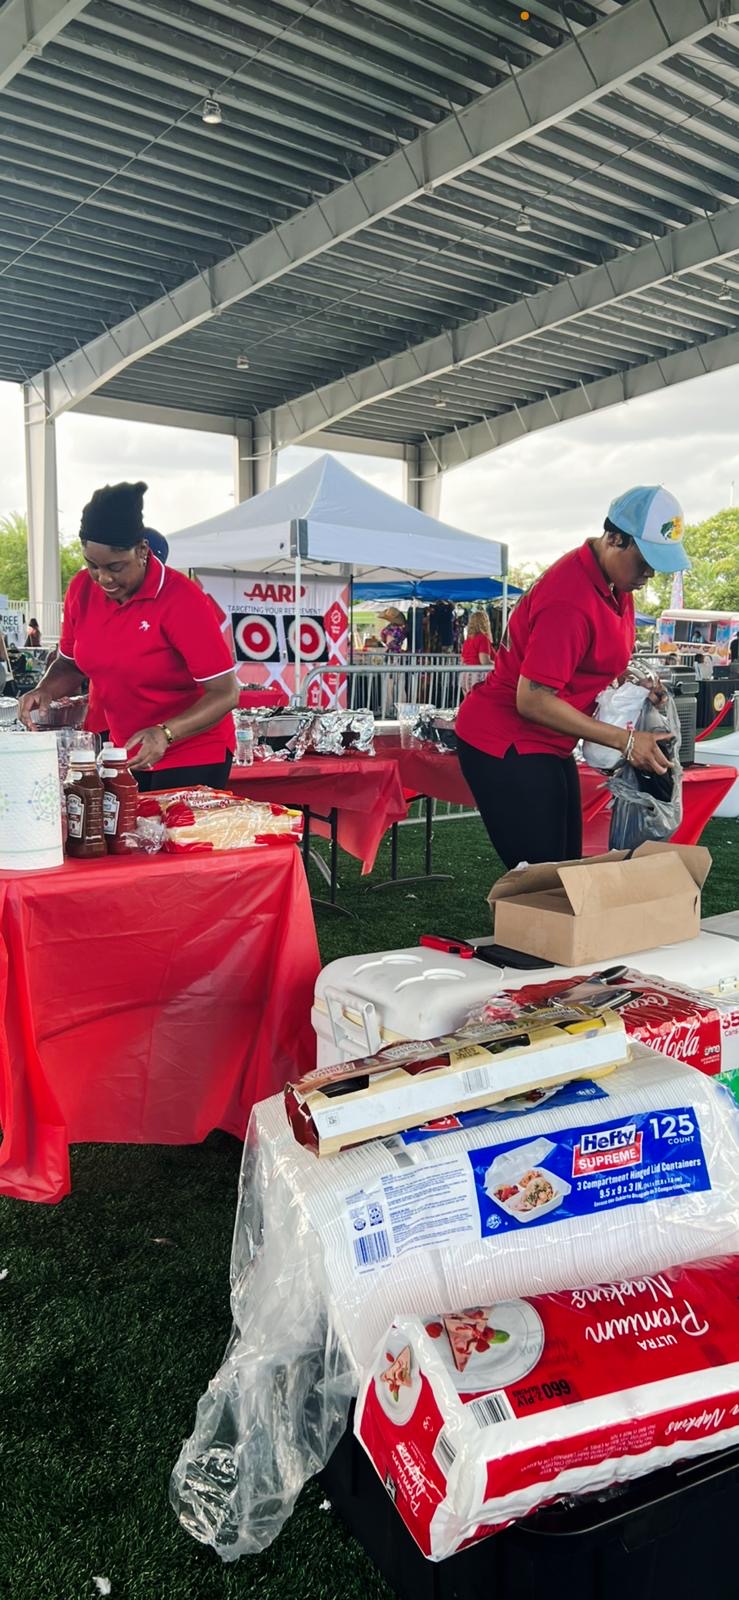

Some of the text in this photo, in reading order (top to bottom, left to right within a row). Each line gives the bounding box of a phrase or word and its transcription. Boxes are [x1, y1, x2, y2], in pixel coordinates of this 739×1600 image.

[244, 583, 306, 603] AARP
[3, 615, 19, 626] REE
[227, 604, 322, 616] TARGETING YOUR RETEMENT
[649, 1114, 695, 1140] 125
[583, 1129, 634, 1151] Hefty
[667, 1135, 695, 1145] COUNT
[579, 1148, 637, 1170] SUPREME
[576, 1158, 701, 1191] 3 Compartment Hinged Lid Containers
[600, 1187, 611, 1199] 9.5
[611, 1188, 617, 1196] x
[617, 1184, 623, 1195] 9
[623, 1185, 628, 1193] x
[628, 1182, 634, 1192] 3
[571, 1274, 675, 1309] Napkins
[585, 1299, 710, 1344] Premium
[636, 1334, 678, 1351] ULTRA
[516, 1378, 572, 1408] 660 2-PLY
[664, 1407, 727, 1436] Napkins
[391, 1449, 421, 1518] Premium
